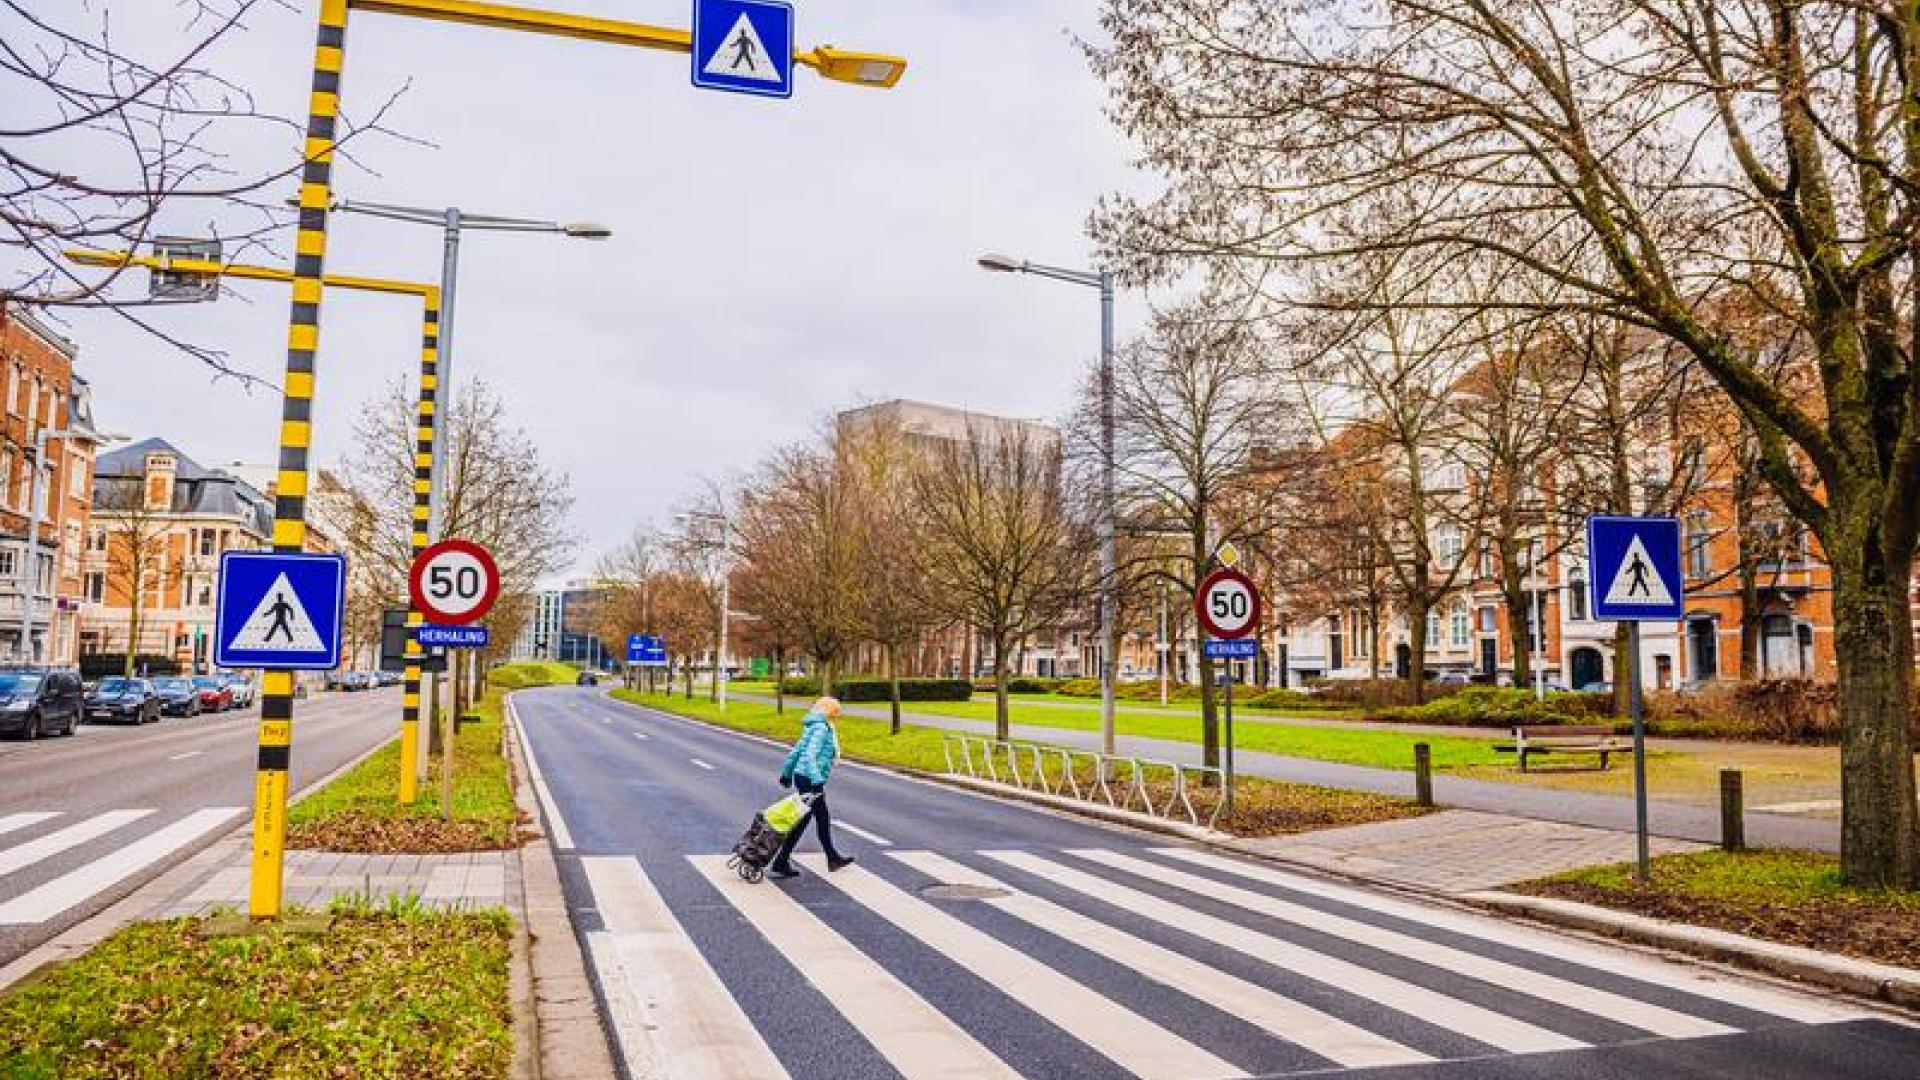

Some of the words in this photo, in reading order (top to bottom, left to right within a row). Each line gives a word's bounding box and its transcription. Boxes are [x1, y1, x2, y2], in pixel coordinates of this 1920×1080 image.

[430, 566, 479, 598] 50
[1212, 591, 1246, 618] 50
[419, 630, 486, 643] HERHALING
